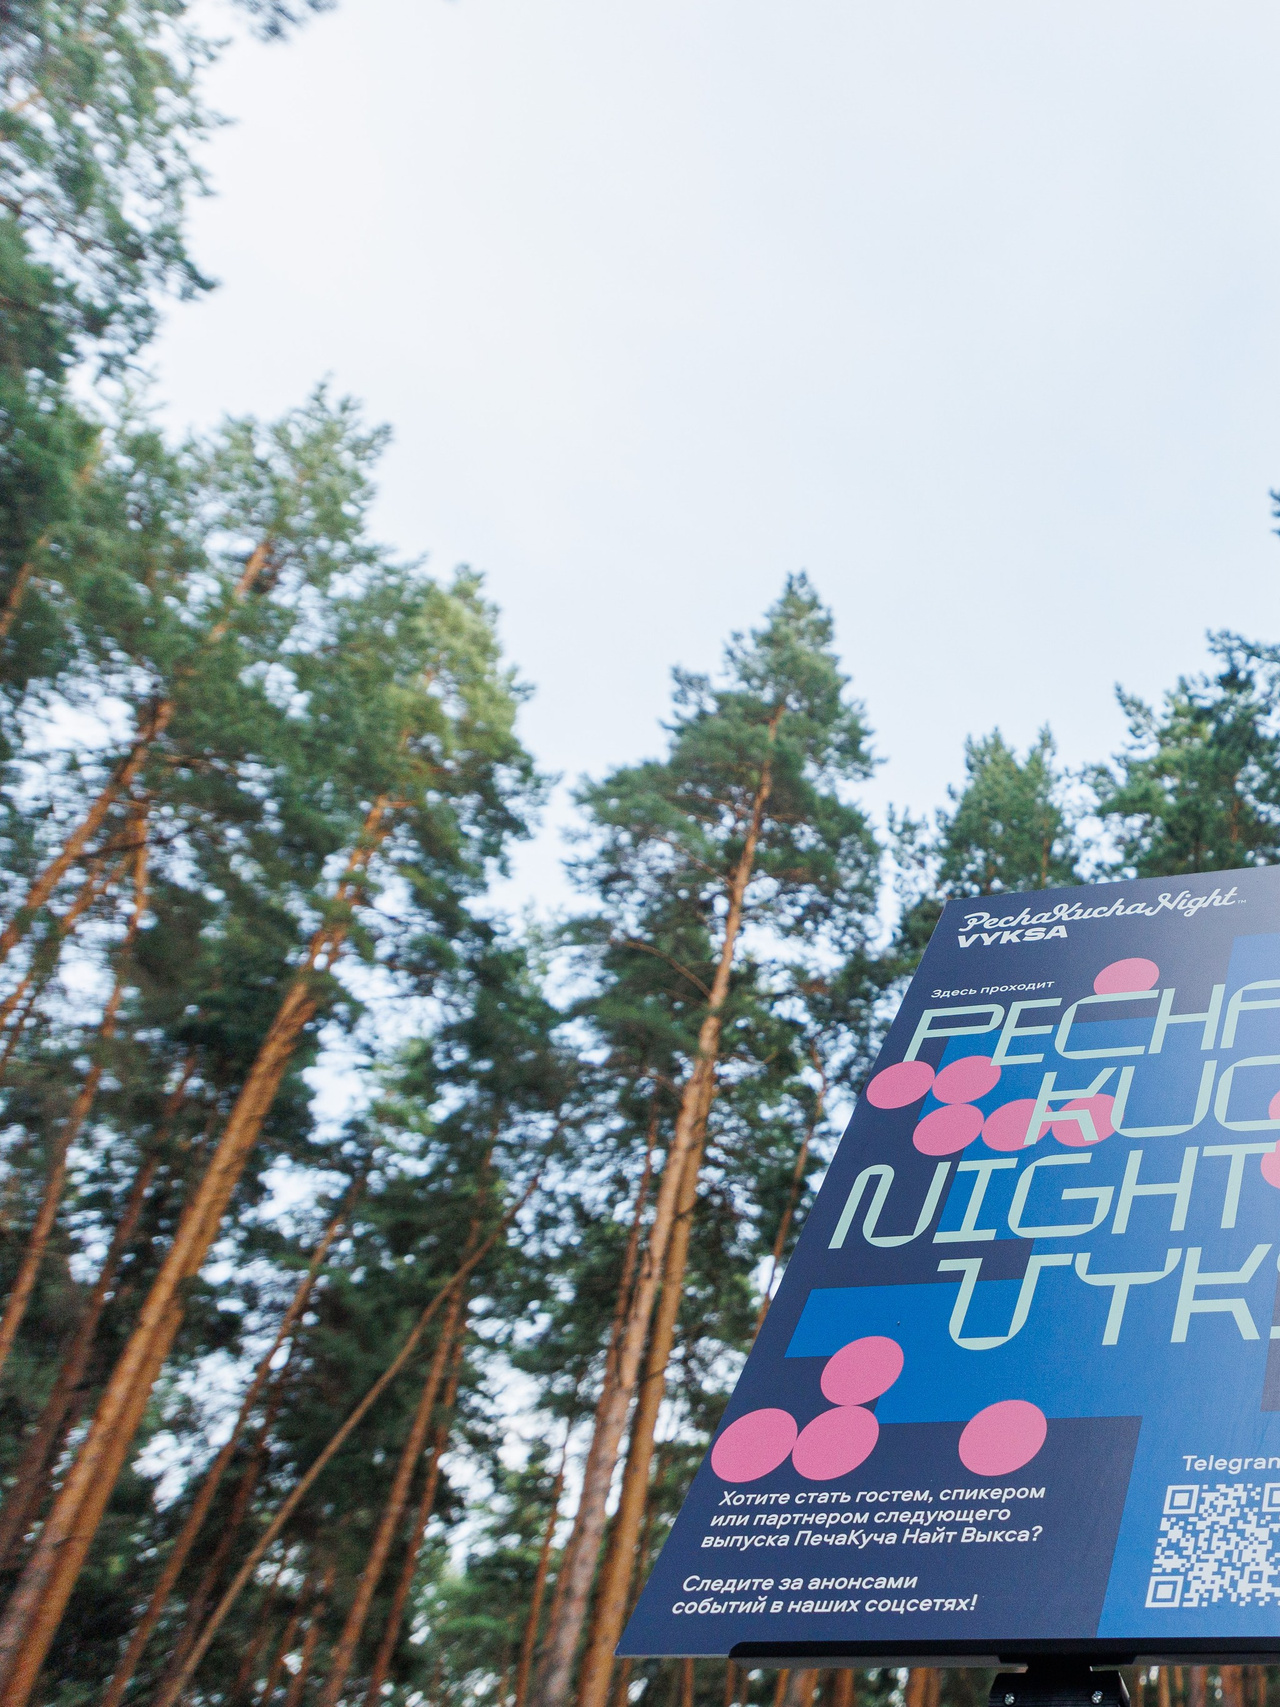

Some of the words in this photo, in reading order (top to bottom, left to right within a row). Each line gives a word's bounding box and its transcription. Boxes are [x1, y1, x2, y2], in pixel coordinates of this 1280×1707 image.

[957, 925, 1068, 948] VYKSA
[931, 989, 977, 999] Здесь
[980, 981, 1055, 995] проходит
[828, 1143, 1277, 1249] NIGHT
[718, 1490, 790, 1506] Хотите
[794, 1490, 852, 1505] стать
[856, 1488, 934, 1504] гостем,
[939, 1485, 1046, 1504] спикером
[710, 1513, 749, 1527] или
[753, 1509, 869, 1530] партнером
[874, 1508, 1011, 1525] следующего
[701, 1533, 789, 1551] выпуска
[794, 1529, 898, 1550] ПечаКуча
[902, 1526, 957, 1545] Найт
[961, 1525, 1043, 1544] Выкса?
[682, 1575, 774, 1594] Следите
[778, 1578, 803, 1591] за
[808, 1575, 918, 1591] анонсами
[671, 1597, 767, 1615] событий
[770, 1601, 783, 1614] в
[787, 1598, 861, 1613] наших
[864, 1594, 978, 1615] соцсетях!
